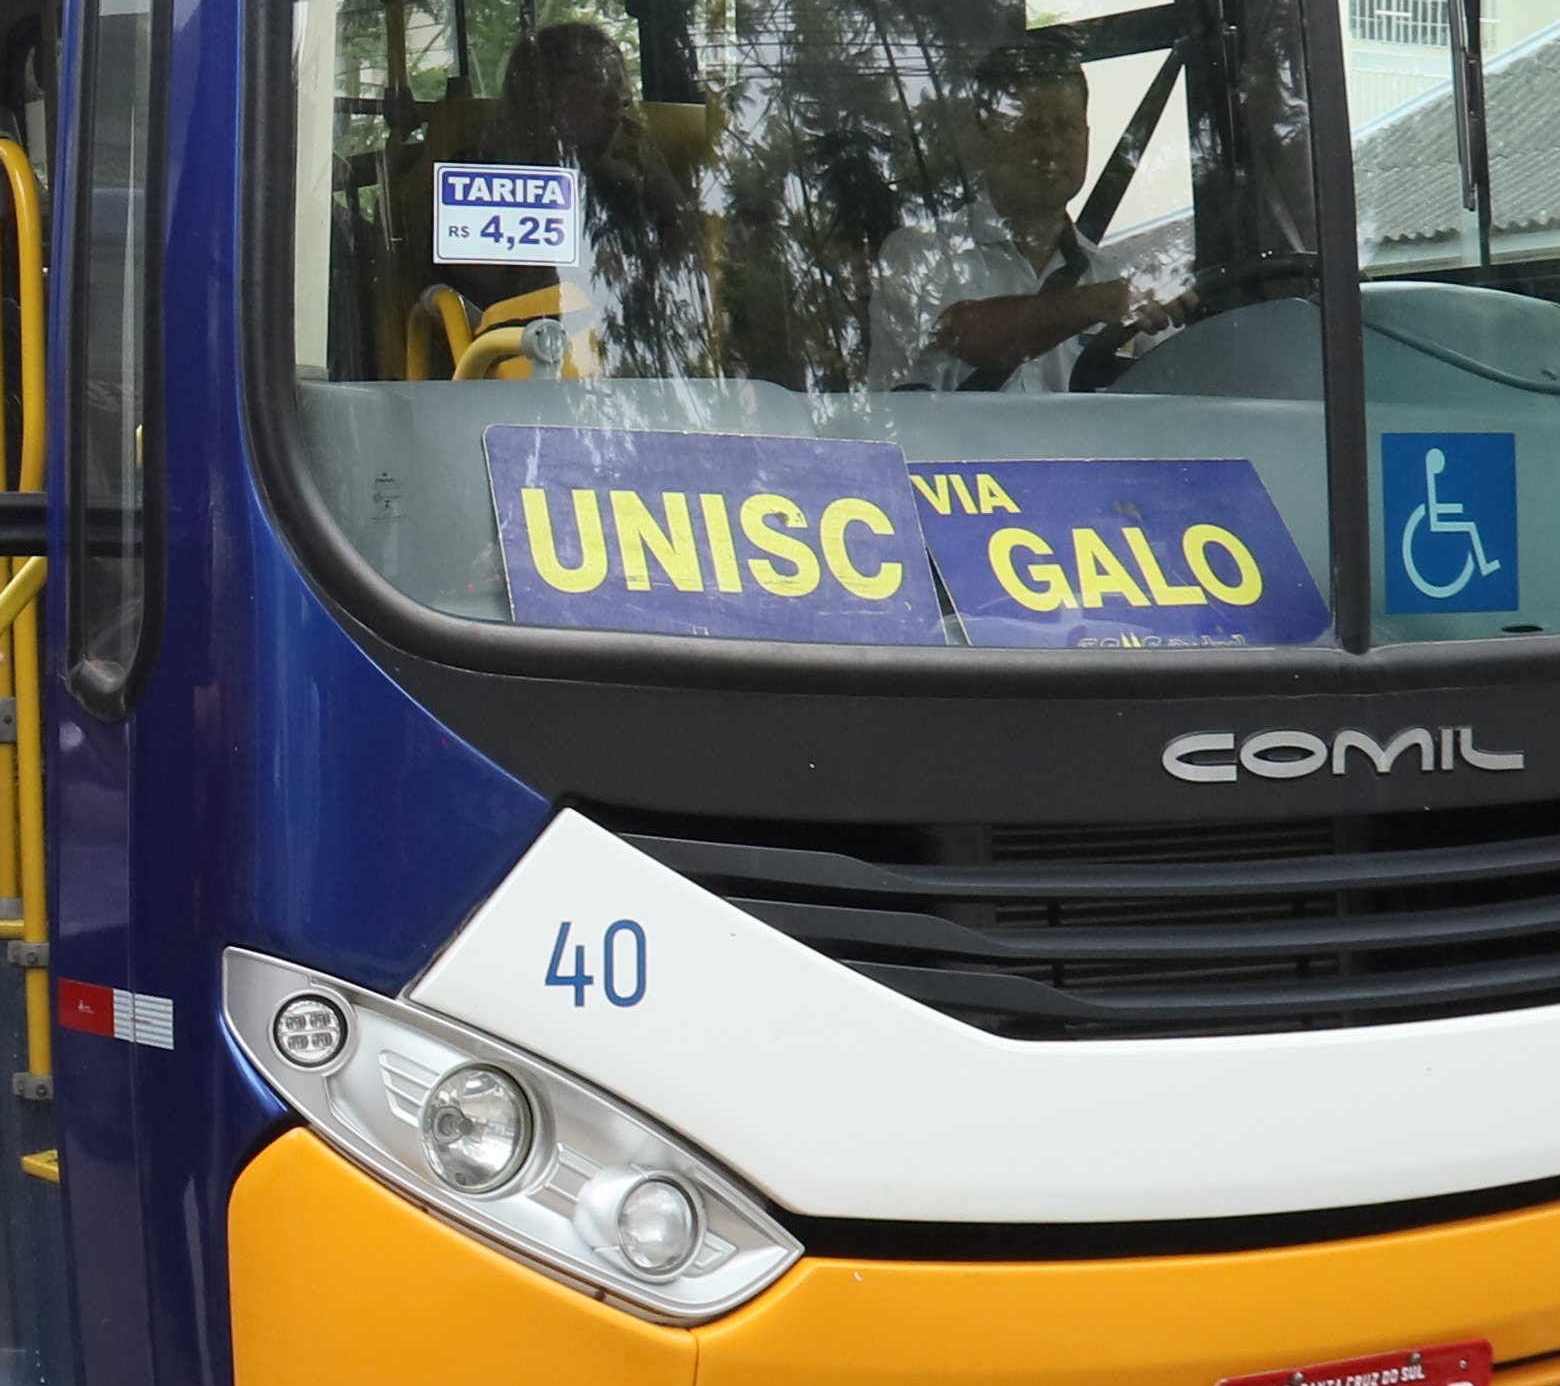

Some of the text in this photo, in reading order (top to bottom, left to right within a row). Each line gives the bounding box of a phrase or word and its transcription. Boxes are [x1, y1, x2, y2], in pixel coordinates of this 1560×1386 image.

[447, 176, 566, 205] TARIFA
[448, 215, 565, 250] R$ 4,25
[910, 471, 1022, 516] VIA
[520, 487, 904, 601] UNISC
[986, 523, 1264, 613] GALO
[1162, 725, 1525, 782] COMIL
[545, 919, 646, 1007] 40
[1381, 1368, 1400, 1386] DO
[1400, 1365, 1426, 1382] SUL
